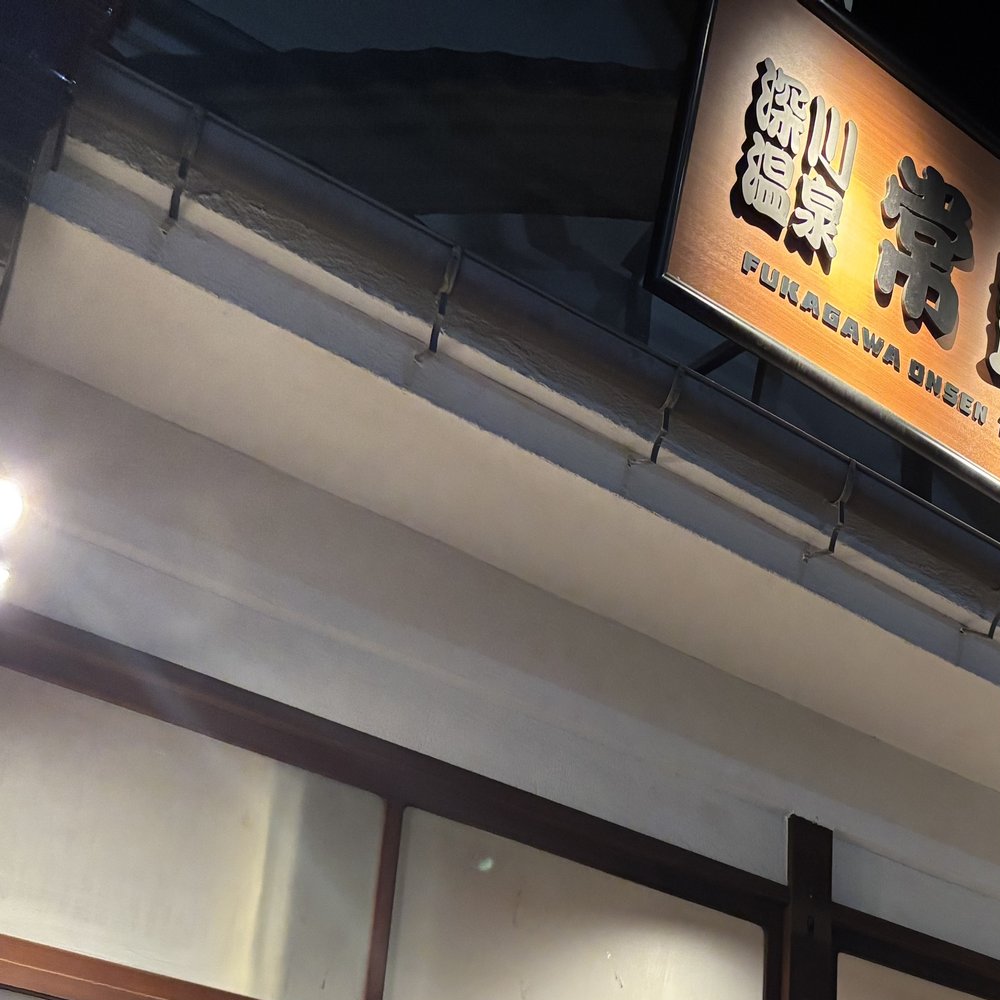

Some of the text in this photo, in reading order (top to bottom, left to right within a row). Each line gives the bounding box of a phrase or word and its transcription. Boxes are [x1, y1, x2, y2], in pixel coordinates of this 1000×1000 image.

[756, 58, 857, 190] 深川
[740, 132, 844, 262] 温泉
[741, 250, 901, 373] FUKAGAWA
[907, 358, 988, 427] ONSEN
